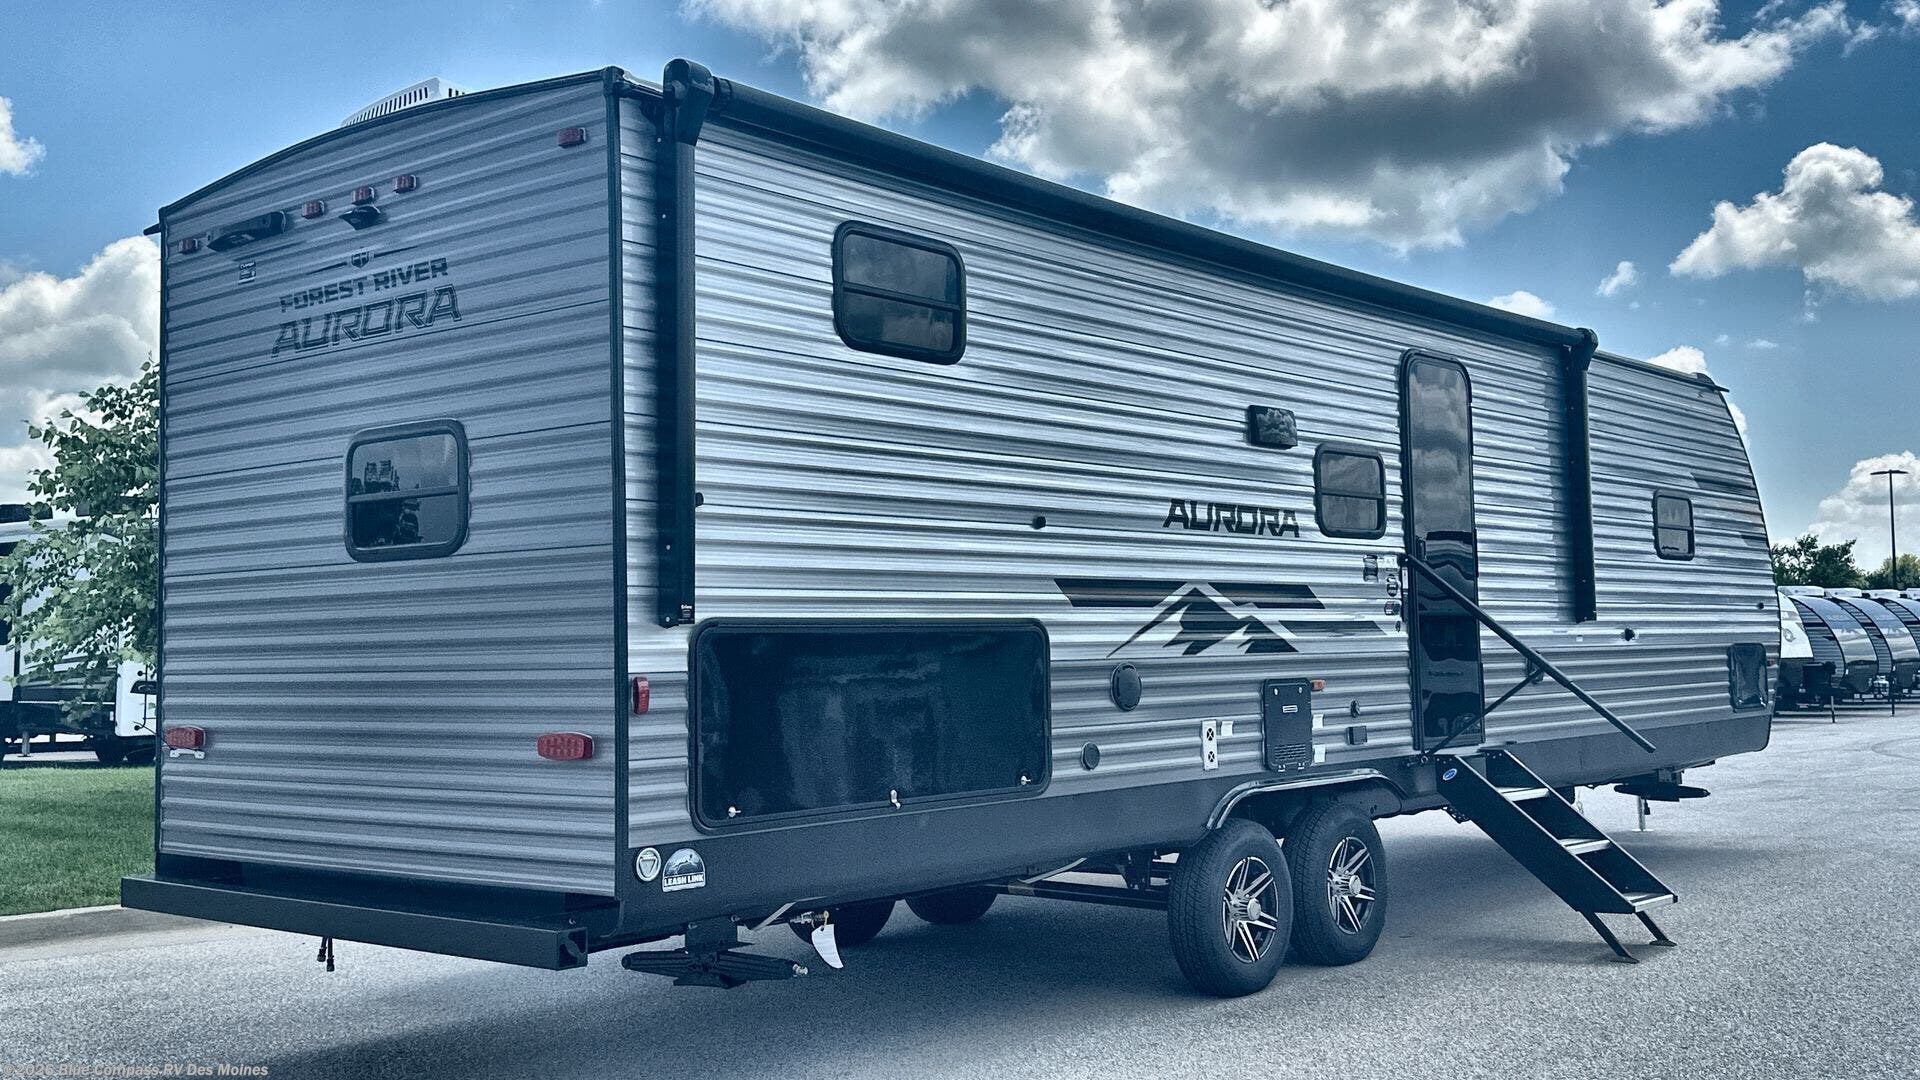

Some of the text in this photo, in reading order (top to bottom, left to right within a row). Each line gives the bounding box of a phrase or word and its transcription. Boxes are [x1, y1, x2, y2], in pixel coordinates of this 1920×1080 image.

[279, 257, 448, 313] FOREST RIVER
[271, 283, 462, 358] AURORA
[1163, 498, 1300, 538] AURORA
[664, 873, 704, 886] LEASH LINK
